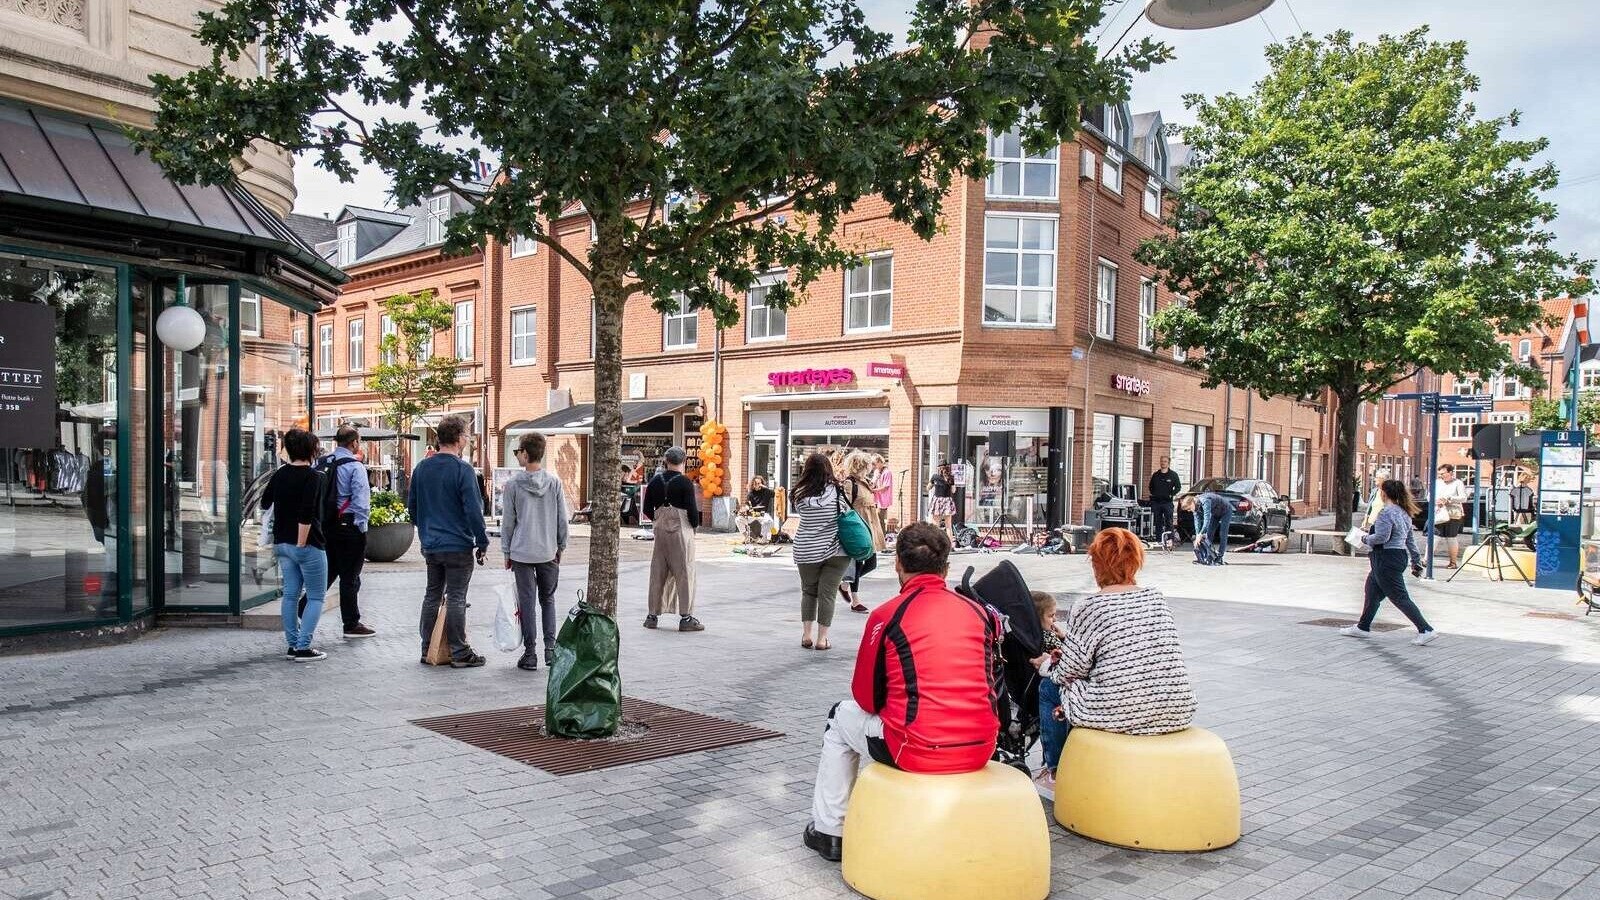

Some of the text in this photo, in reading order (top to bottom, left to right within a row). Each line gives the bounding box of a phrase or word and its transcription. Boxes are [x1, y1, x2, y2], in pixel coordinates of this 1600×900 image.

[1, 372, 42, 384] TTET
[768, 368, 854, 388] smarteyes
[873, 365, 901, 376] smarteyes
[1115, 374, 1150, 396] smarteyes
